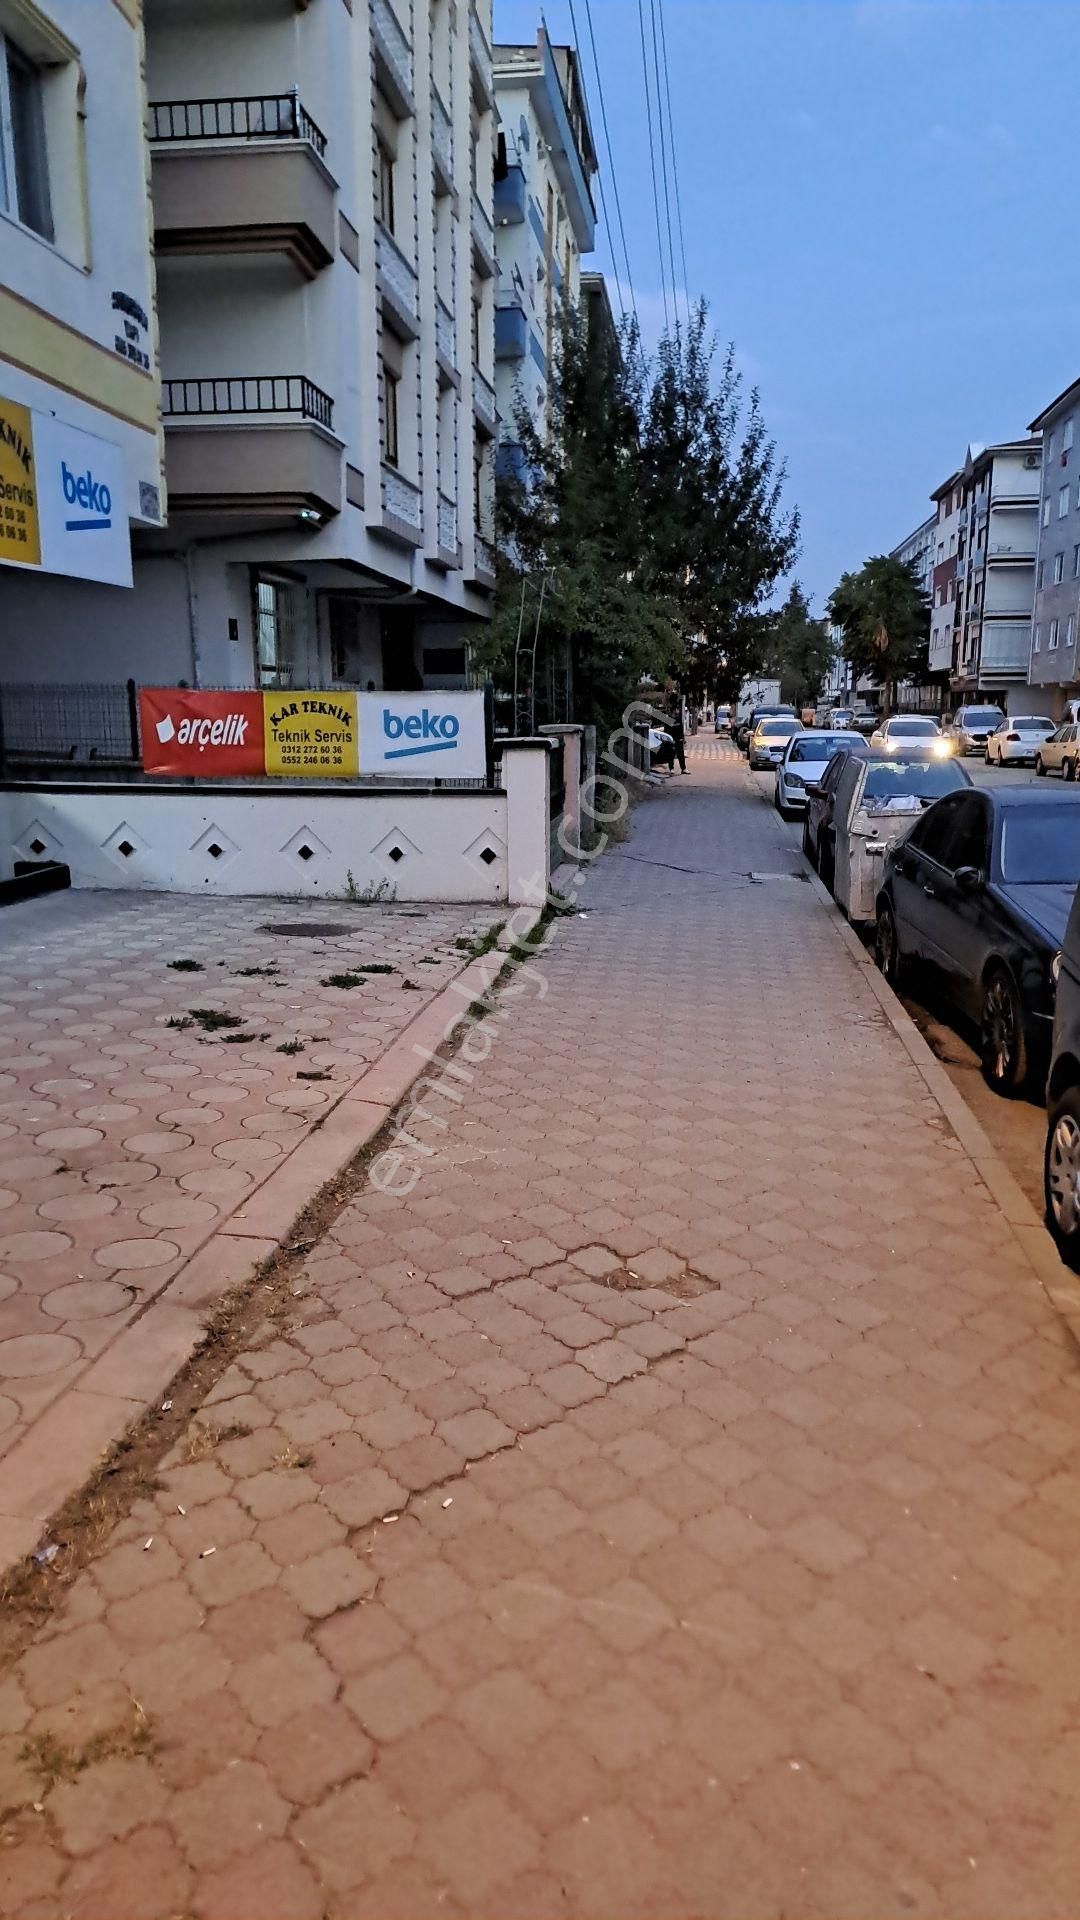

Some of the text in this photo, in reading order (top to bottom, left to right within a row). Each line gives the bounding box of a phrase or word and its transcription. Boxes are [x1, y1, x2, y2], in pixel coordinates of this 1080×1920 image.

[61, 461, 112, 515] beko
[269, 701, 353, 727] KAR TEKNİK
[383, 709, 460, 739] beko
[177, 714, 249, 752] arçelik
[271, 728, 353, 743] Teknik Servis
[281, 745, 301, 754] 0312
[303, 745, 318, 754] 272
[320, 745, 330, 754] 60
[281, 756, 301, 765] 0552
[303, 756, 318, 765] 246
[332, 756, 343, 765] 36
